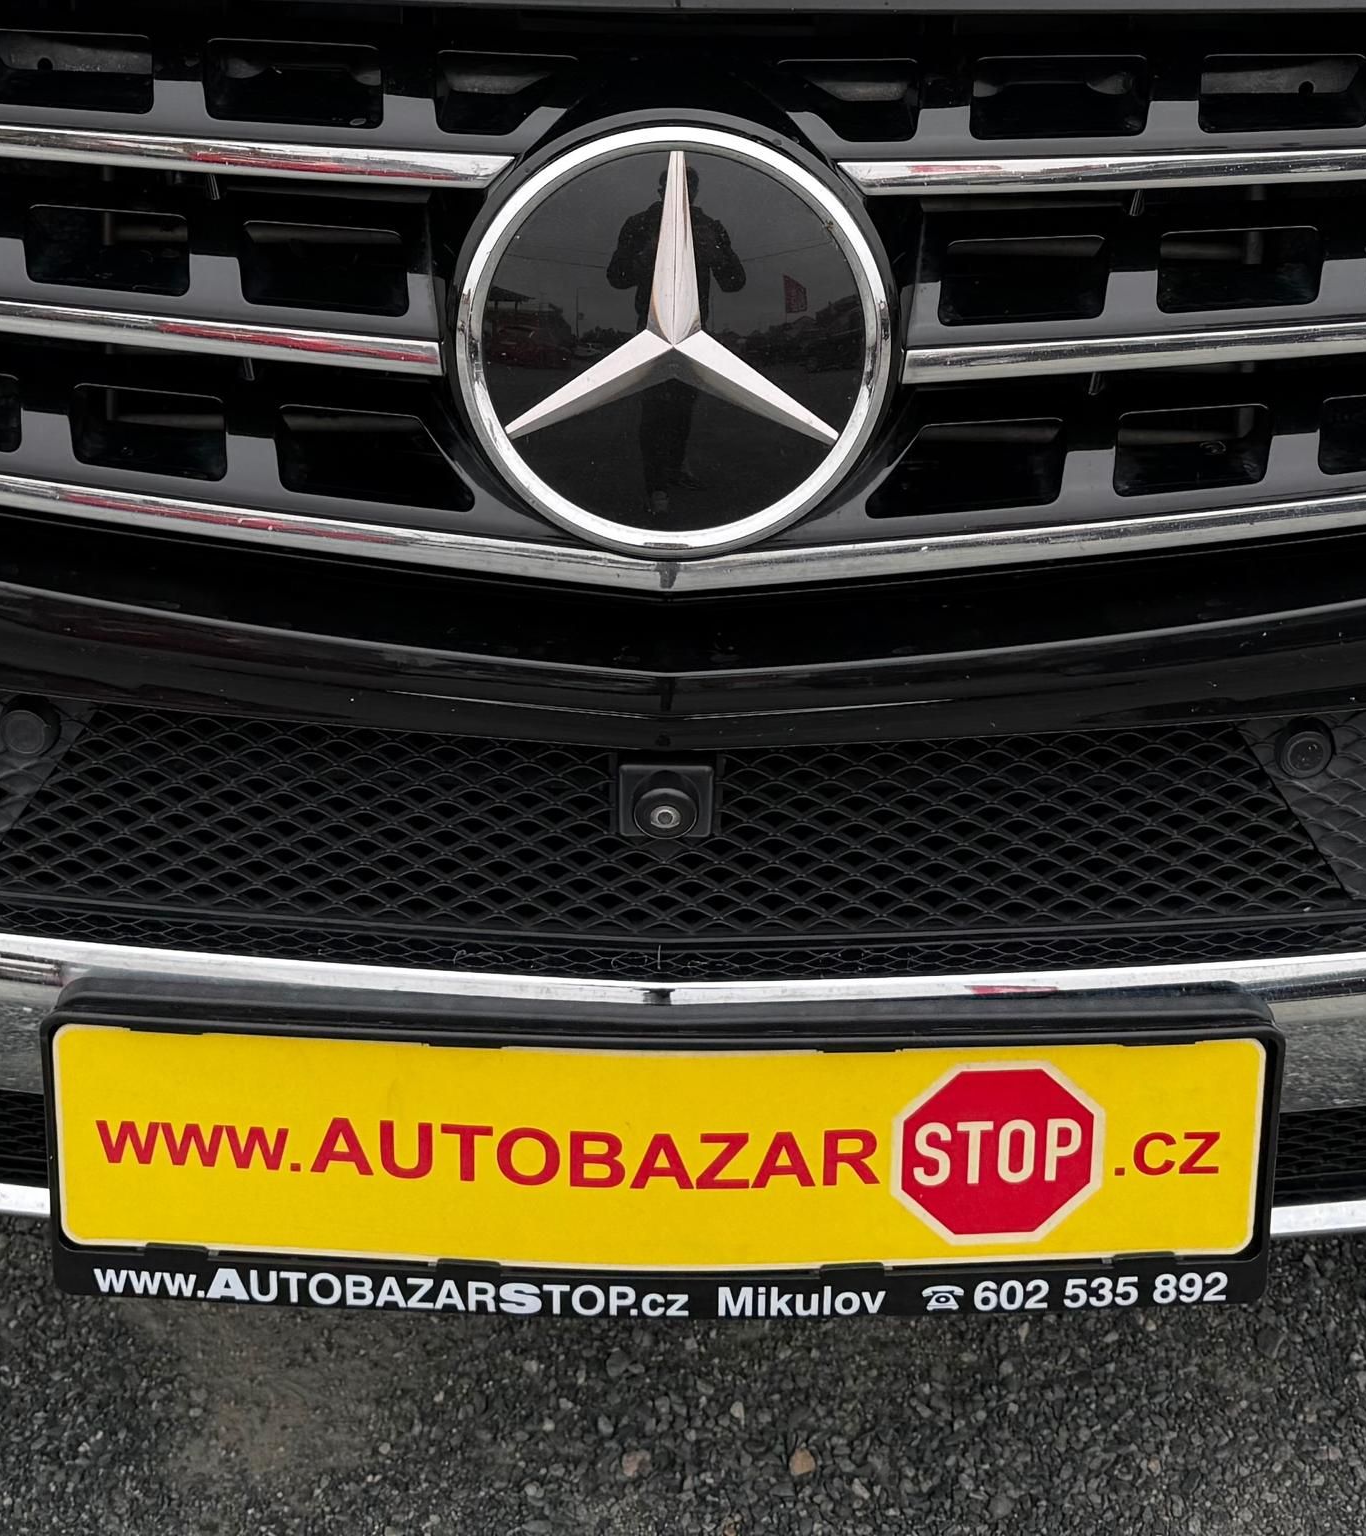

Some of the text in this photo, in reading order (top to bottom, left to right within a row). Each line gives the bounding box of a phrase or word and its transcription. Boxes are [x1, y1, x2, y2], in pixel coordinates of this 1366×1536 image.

[912, 1118, 1082, 1186] STOP
[717, 1285, 886, 1317] Mikulov
[973, 1280, 1050, 1313] 602
[1064, 1275, 1139, 1308] 535
[1153, 1271, 1228, 1303] 892
